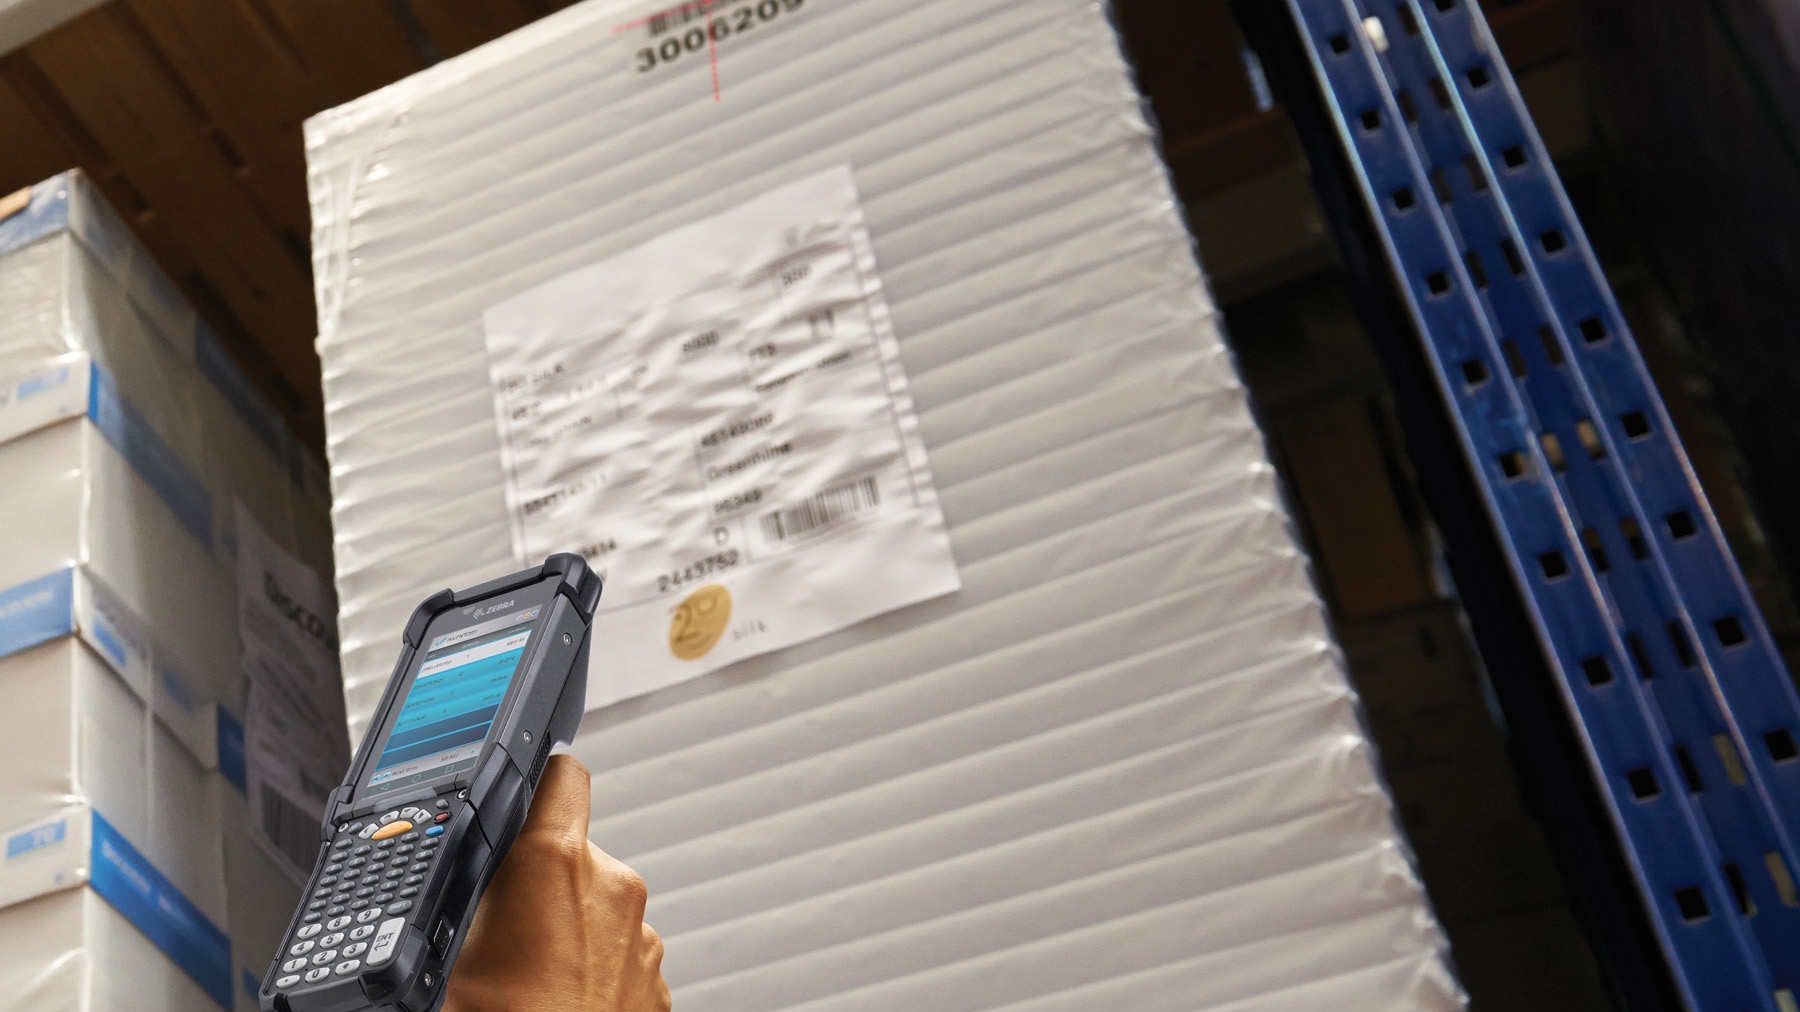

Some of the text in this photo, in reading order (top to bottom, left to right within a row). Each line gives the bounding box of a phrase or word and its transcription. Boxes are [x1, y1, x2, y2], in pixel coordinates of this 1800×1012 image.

[485, 599, 515, 615] ZEBRA
[446, 628, 479, 643] INVENTORY
[440, 753, 459, 763] MENU
[305, 910, 372, 935] 7 8 9
[296, 928, 364, 952] 4 5 6
[376, 932, 394, 942] ENT
[291, 944, 357, 969] 1 2 3
